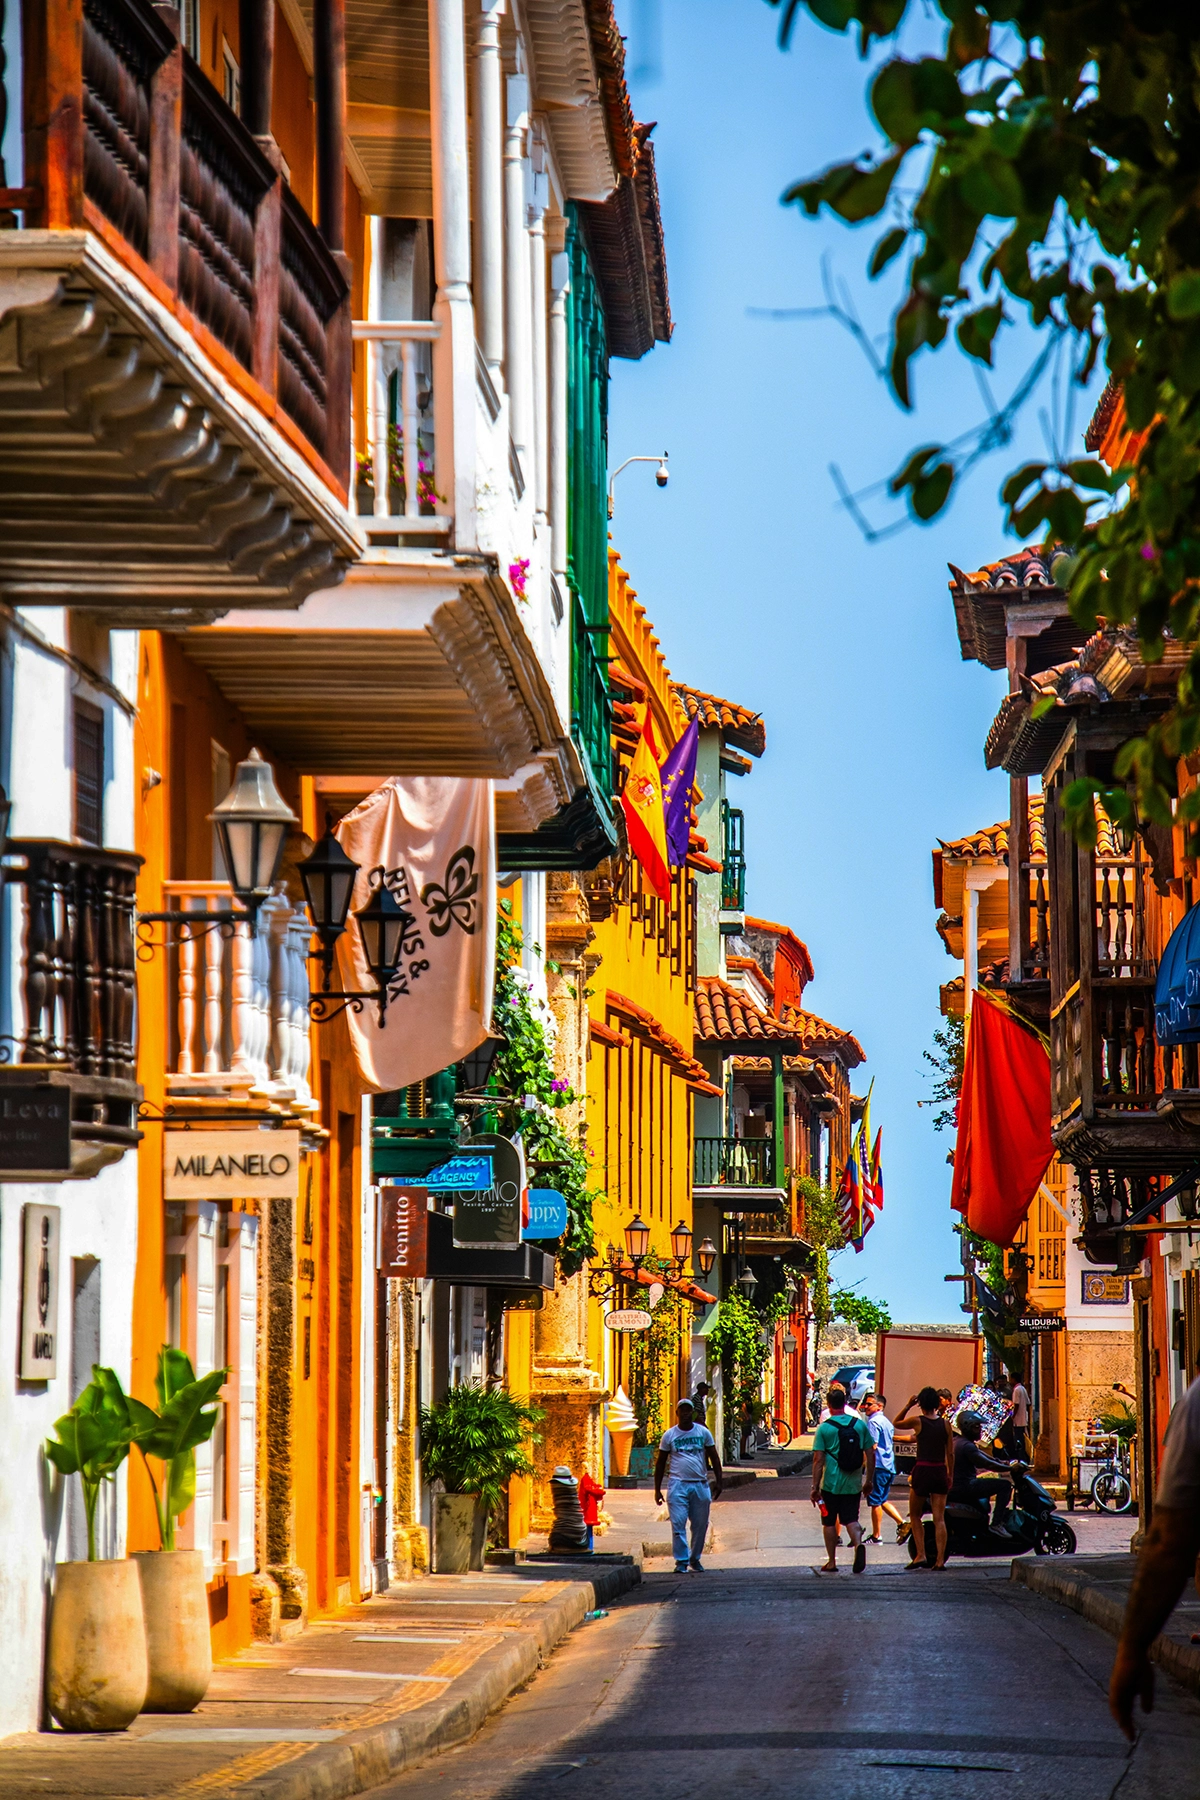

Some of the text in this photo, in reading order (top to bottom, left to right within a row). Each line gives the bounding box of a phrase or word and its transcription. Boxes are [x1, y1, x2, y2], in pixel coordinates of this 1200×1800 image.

[408, 958, 430, 981] &
[3, 1099, 61, 1119] Leva
[174, 1153, 291, 1177] MILANELO
[439, 1171, 480, 1183] AGENCY
[389, 1195, 410, 1268] benitto
[1020, 1319, 1060, 1327] SILIDUBAI
